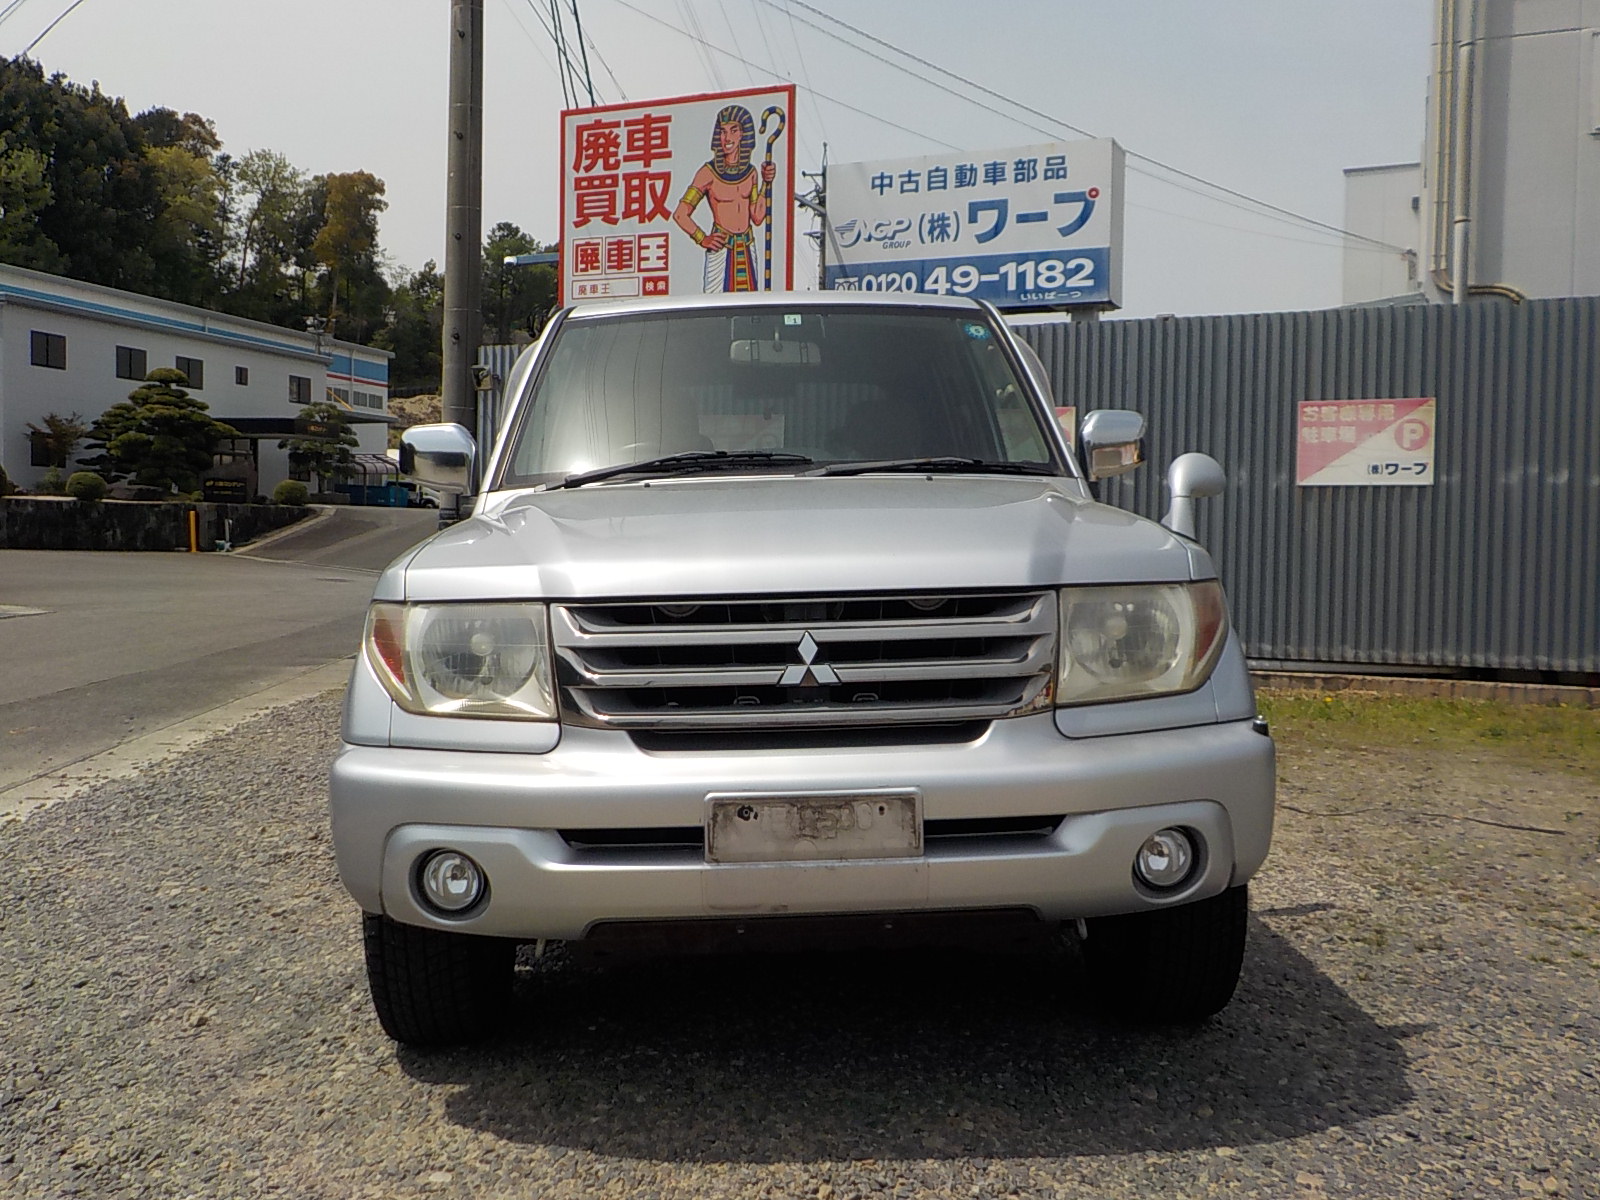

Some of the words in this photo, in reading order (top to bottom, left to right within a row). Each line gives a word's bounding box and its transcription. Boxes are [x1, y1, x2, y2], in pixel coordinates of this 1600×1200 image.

[572, 113, 673, 173] 廃車
[871, 155, 1068, 196] 中古自動車部品
[572, 170, 673, 228] 買取
[573, 233, 669, 274] 廃車王
[882, 240, 912, 250] GROUP
[578, 283, 610, 296] 廃車王
[645, 280, 667, 293] 検索
[862, 271, 918, 293] 0120
[924, 257, 1095, 295] 49-1182
[1402, 422, 1424, 448] P
